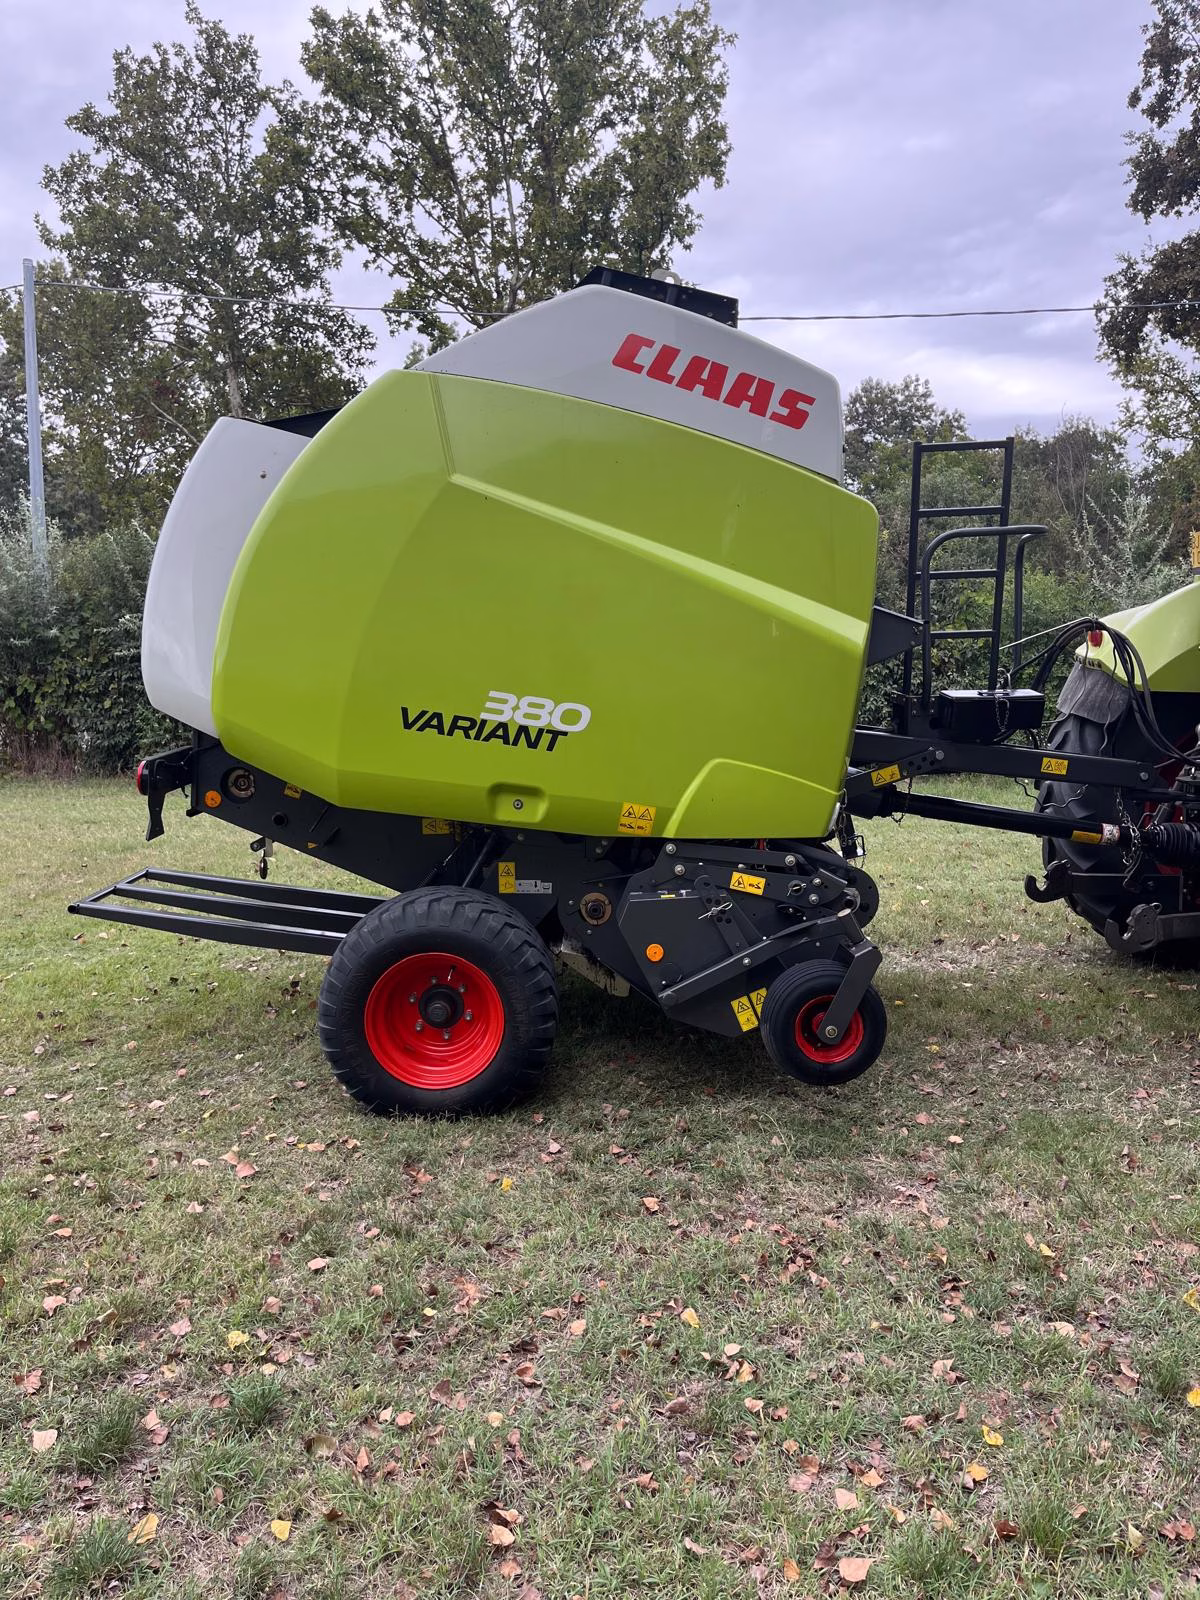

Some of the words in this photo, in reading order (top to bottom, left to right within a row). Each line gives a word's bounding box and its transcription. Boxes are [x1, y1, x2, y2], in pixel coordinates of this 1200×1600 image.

[611, 333, 817, 430] CLAAS
[400, 706, 569, 752] VARIANT
[479, 690, 592, 732] 380
